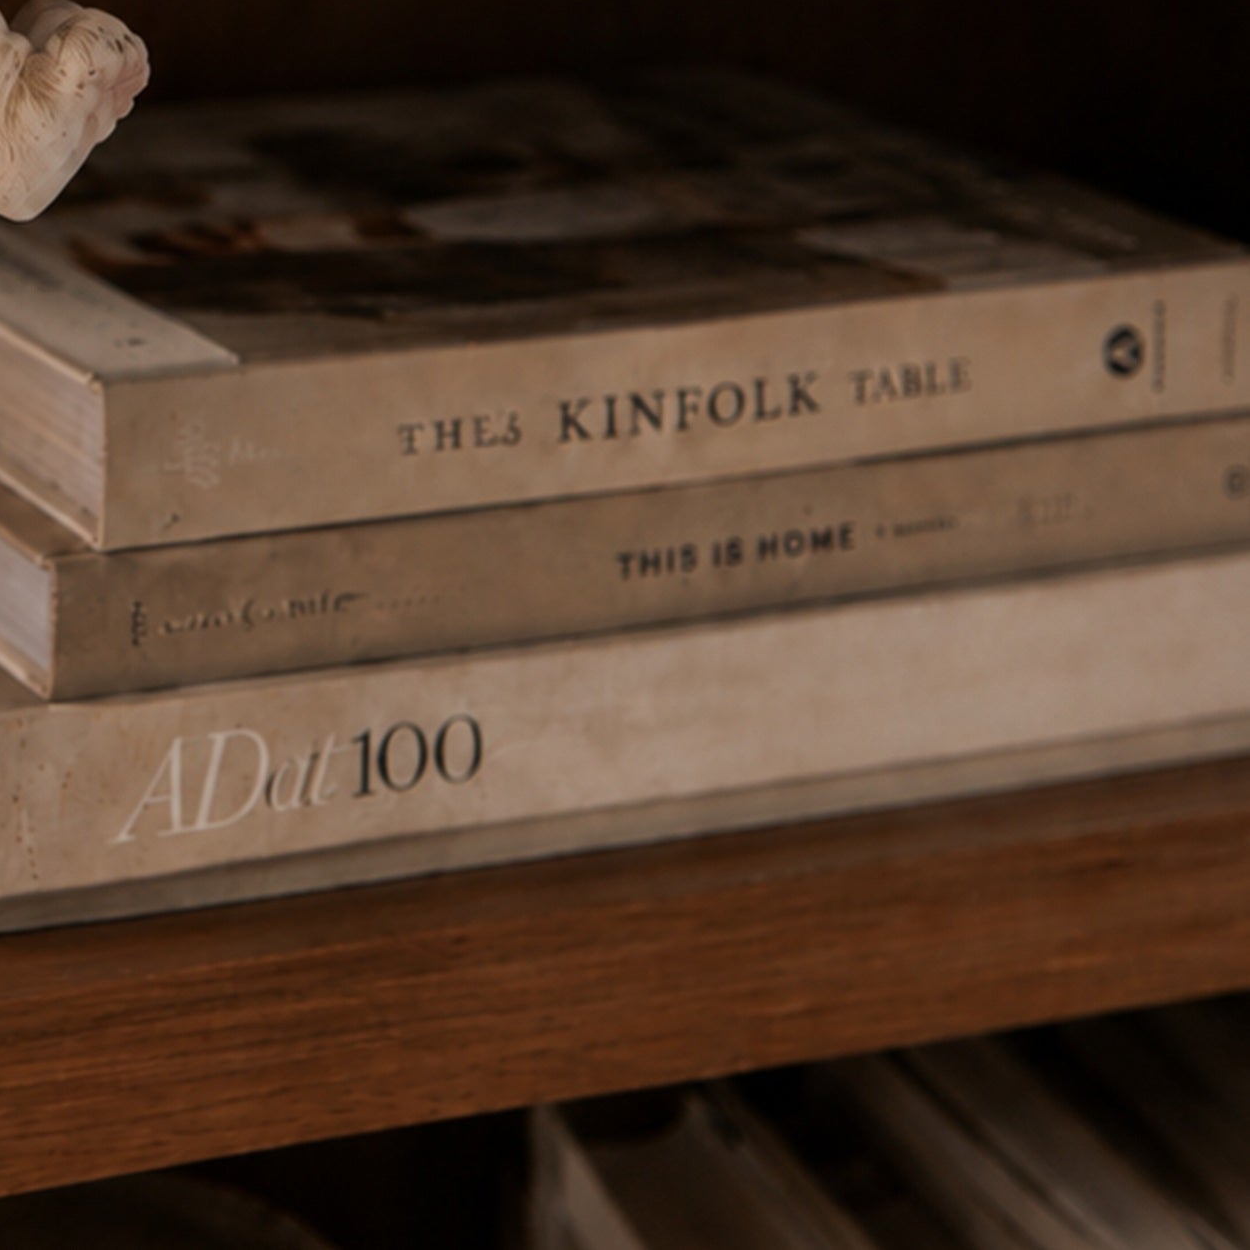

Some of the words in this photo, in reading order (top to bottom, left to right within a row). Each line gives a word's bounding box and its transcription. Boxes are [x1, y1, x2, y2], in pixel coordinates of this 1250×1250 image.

[556, 370, 821, 444] KINFOLK
[851, 357, 973, 406] TABLE
[615, 542, 699, 582] THIS
[710, 536, 745, 570] IS
[755, 520, 857, 563] HOME
